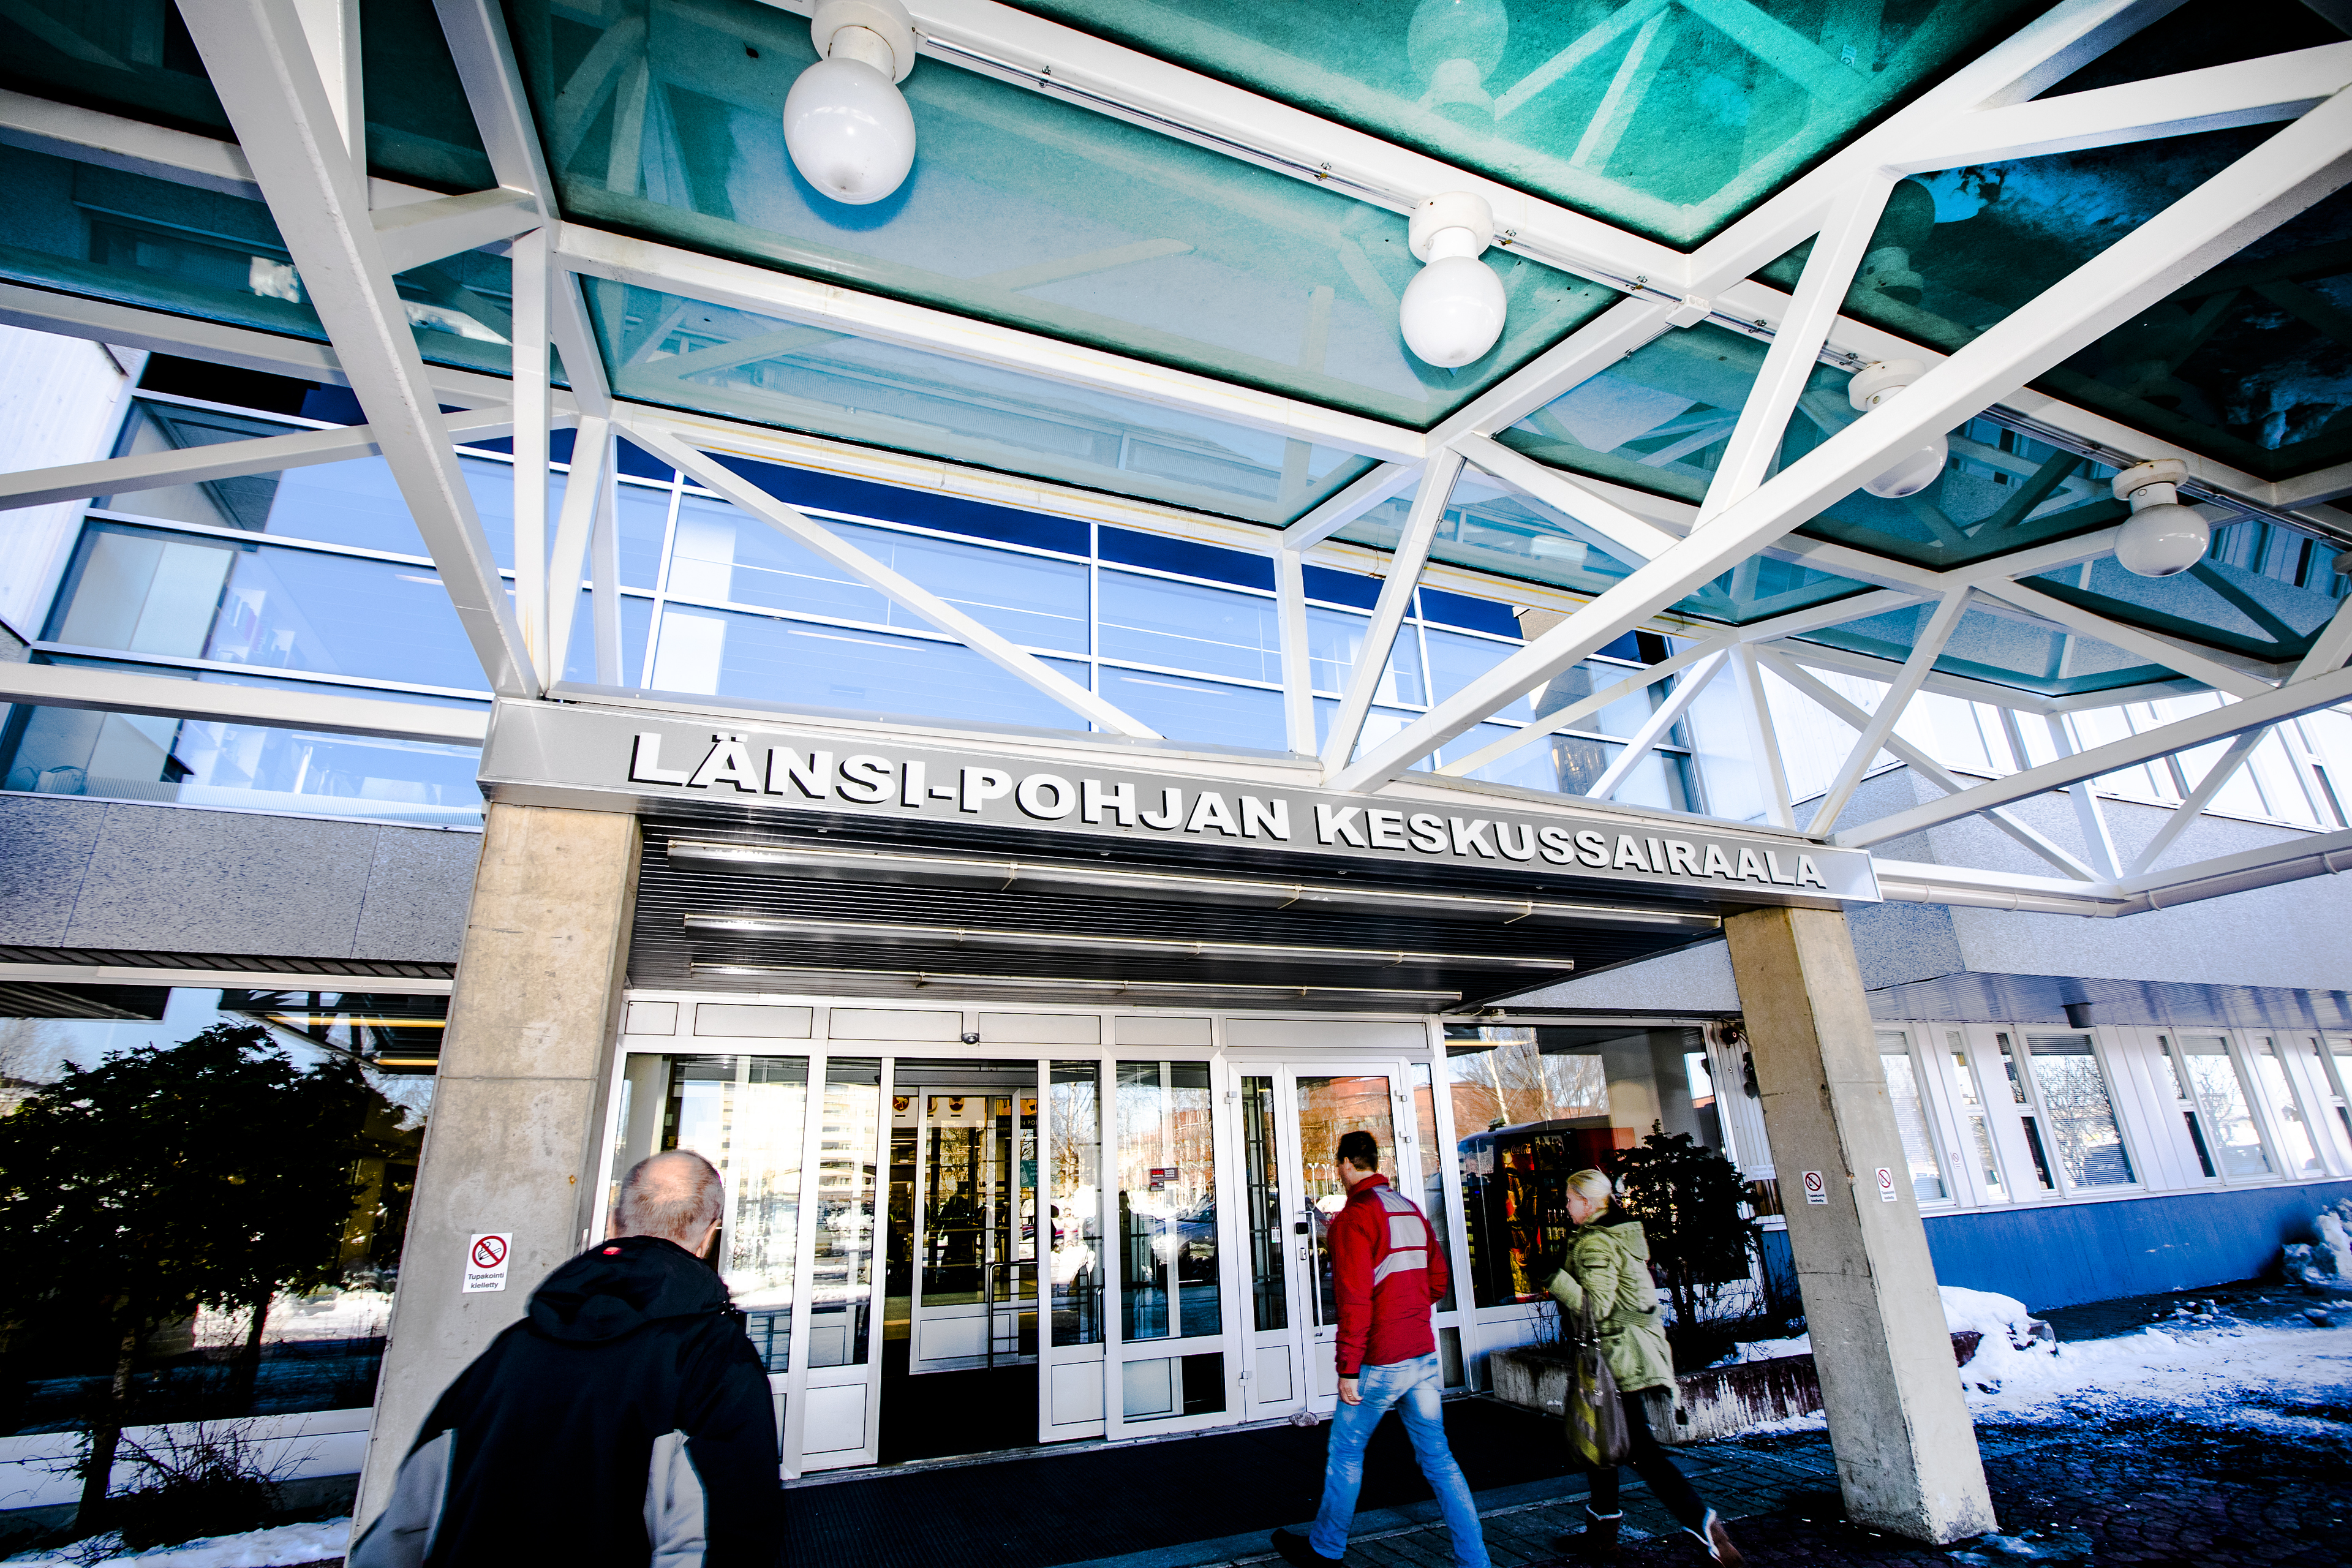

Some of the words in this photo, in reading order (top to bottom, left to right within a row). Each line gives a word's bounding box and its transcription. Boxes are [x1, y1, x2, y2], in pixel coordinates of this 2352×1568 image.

[628, 731, 1291, 842] LÄNSI-POHJAN
[1314, 803, 1827, 889] KESKUSSAIRAALA
[468, 1272, 505, 1281] Tupakointi
